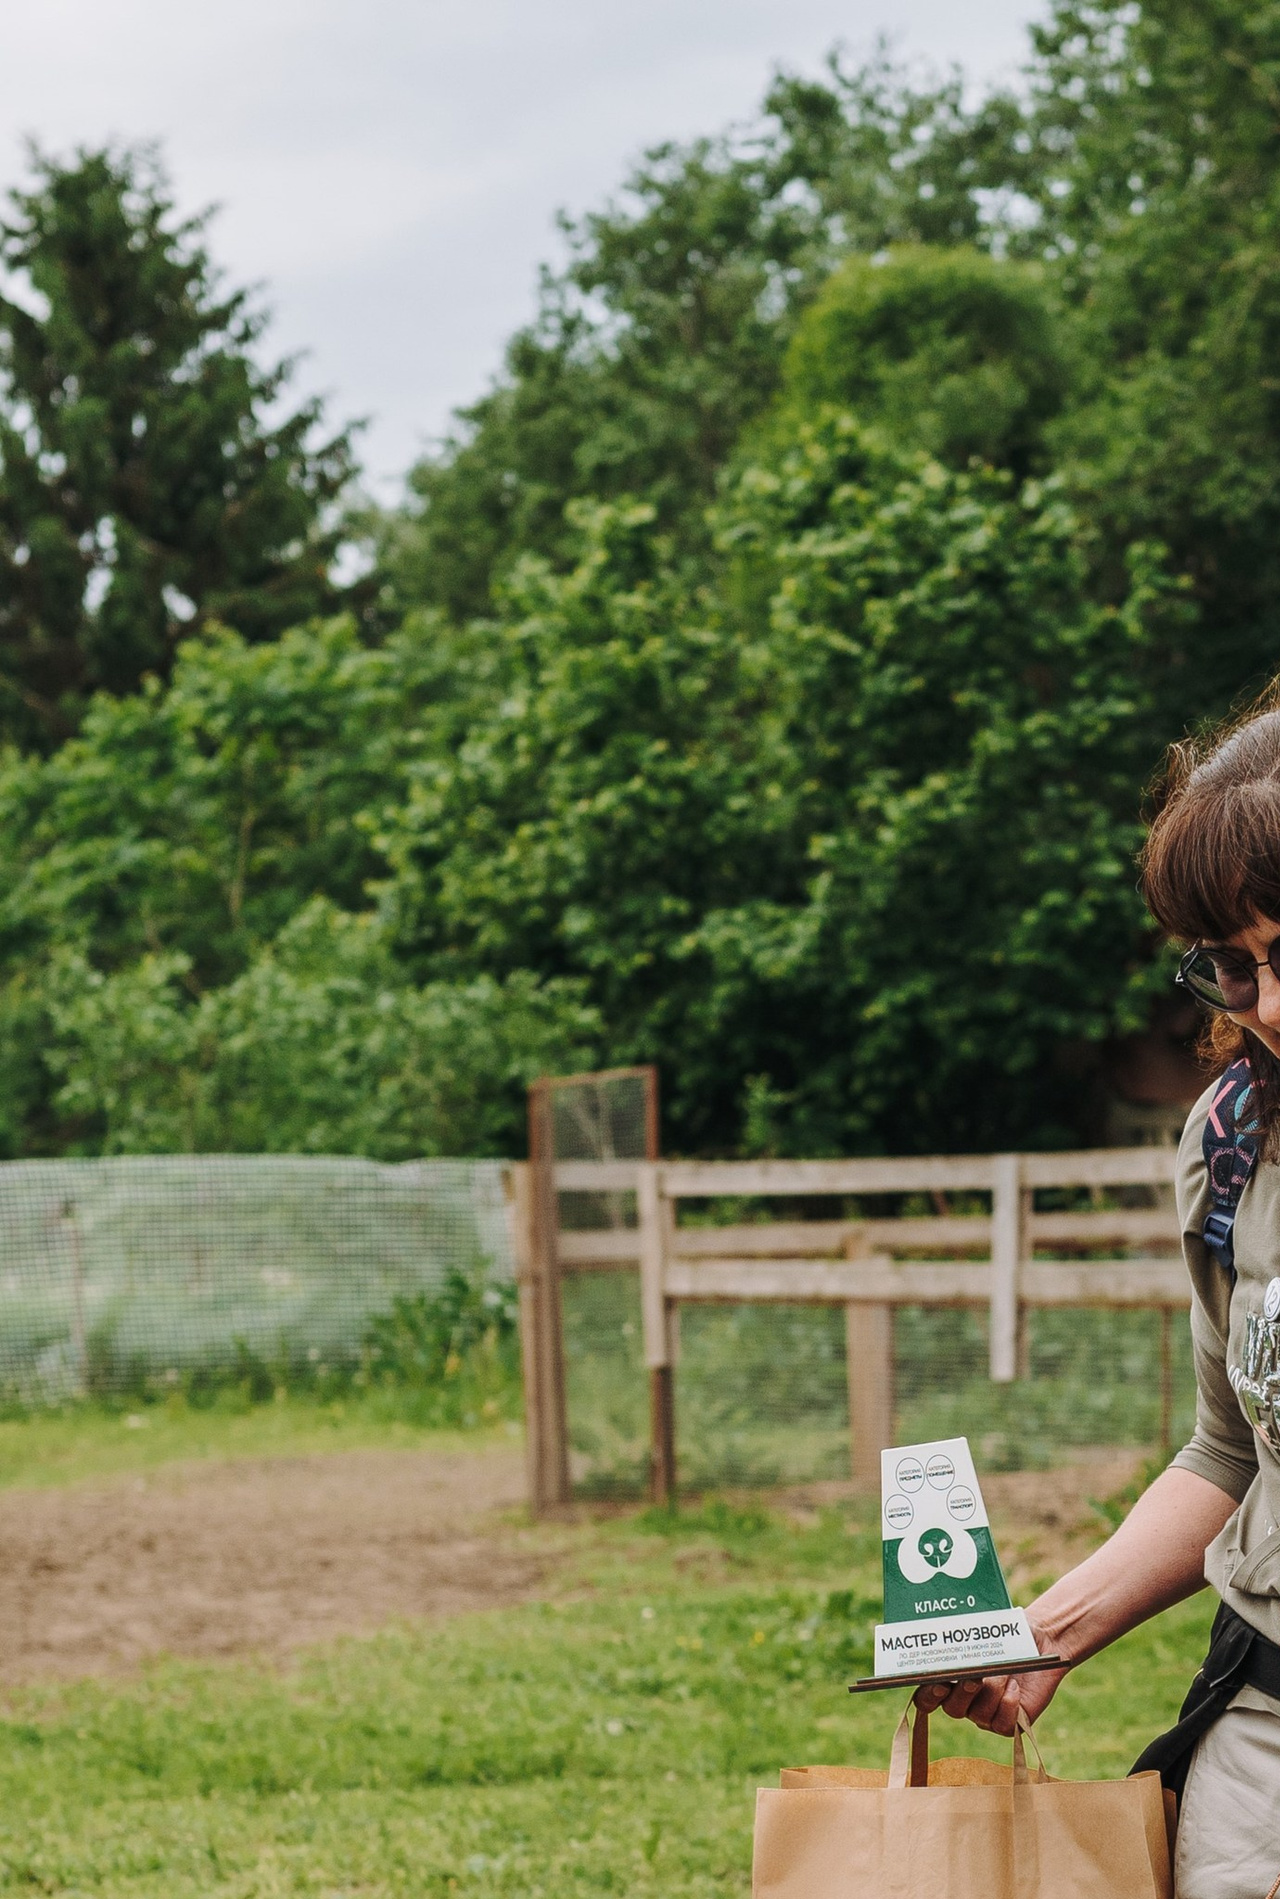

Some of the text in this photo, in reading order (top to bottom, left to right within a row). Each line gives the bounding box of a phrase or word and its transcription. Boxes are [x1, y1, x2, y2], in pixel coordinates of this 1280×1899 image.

[914, 1597, 957, 1614] КЛАСС
[881, 1622, 1021, 1652] МАСТЕР НОУЗВОРК
